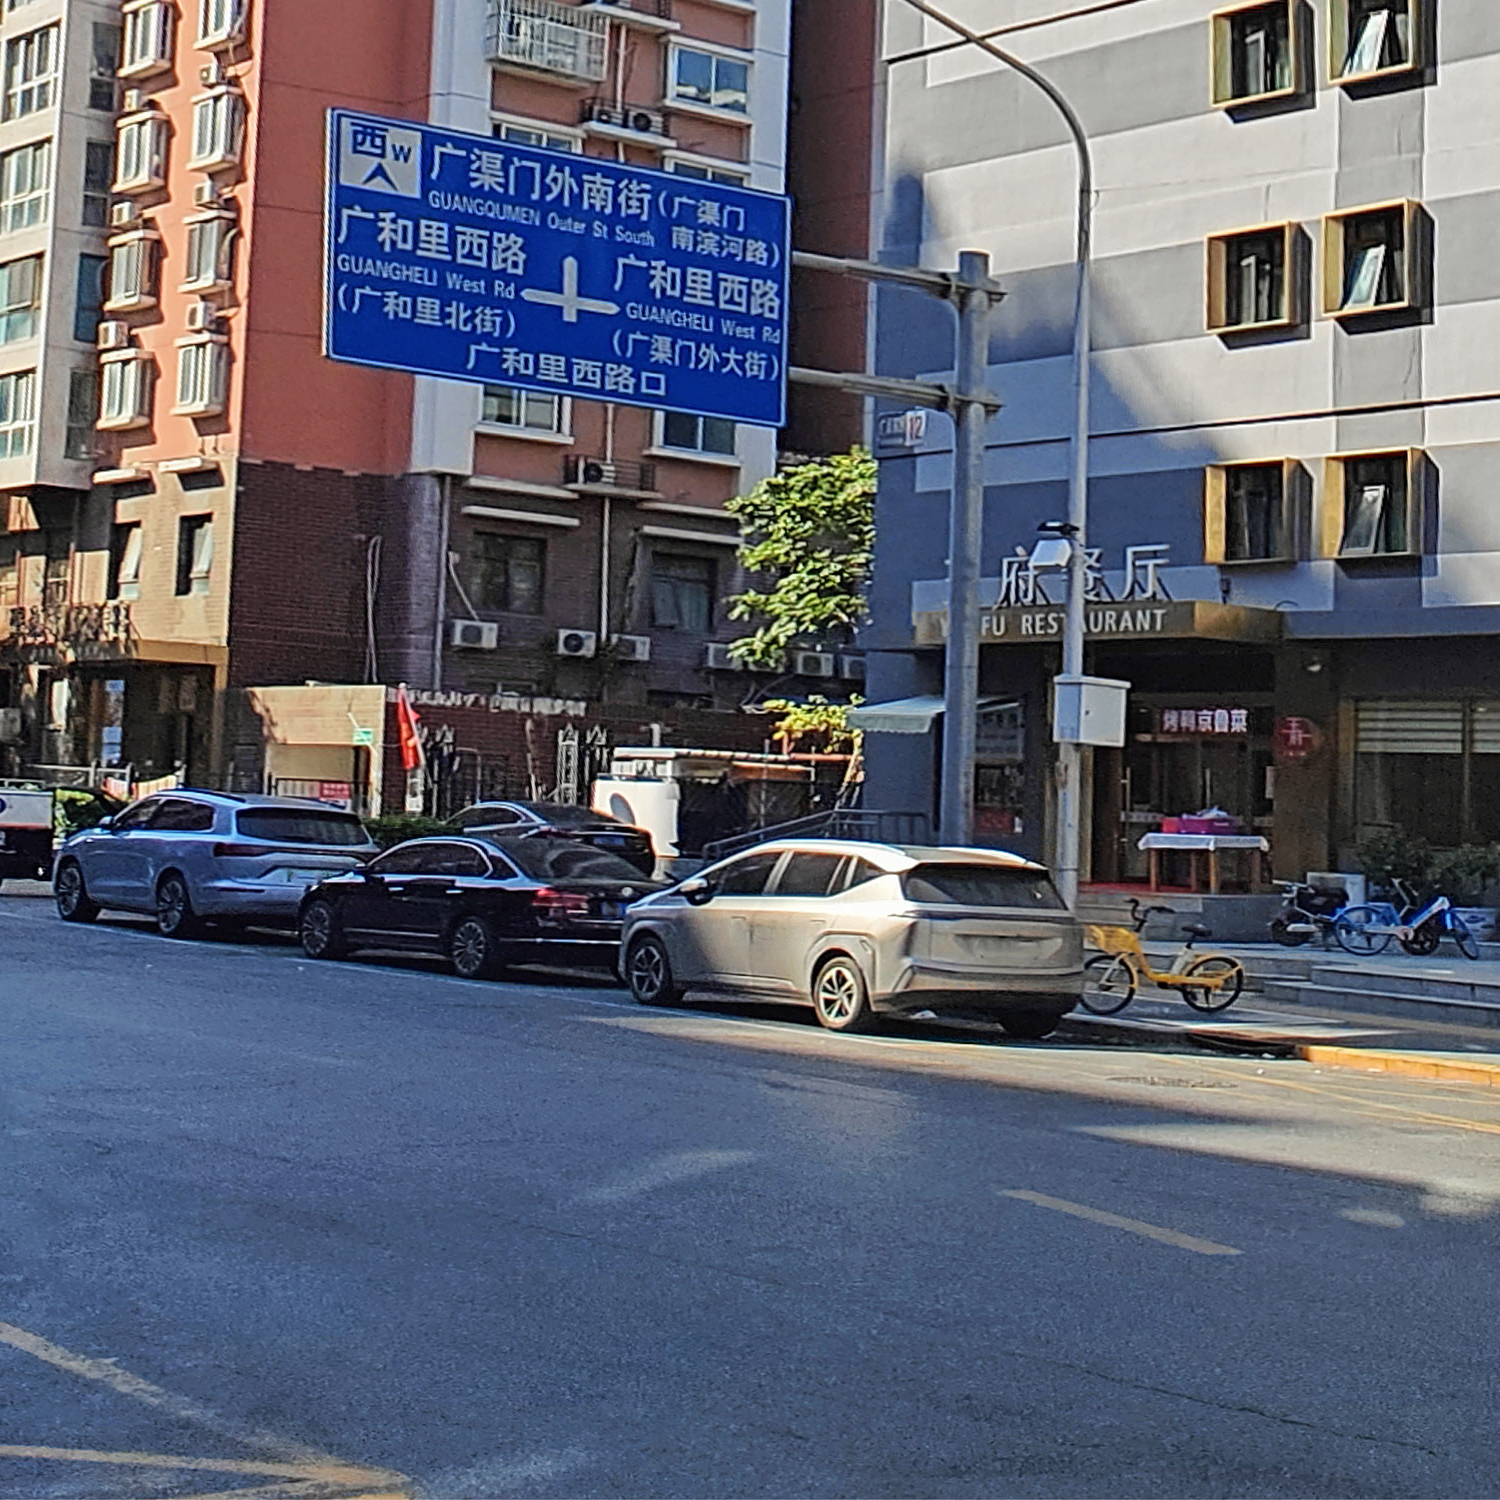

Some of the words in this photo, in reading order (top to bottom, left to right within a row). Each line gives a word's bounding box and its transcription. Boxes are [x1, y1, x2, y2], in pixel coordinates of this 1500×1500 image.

[349, 121, 389, 160] 西
[391, 143, 412, 164] W
[430, 142, 652, 222] 广渠门外南街
[337, 205, 527, 277] 广和里西路
[428, 190, 541, 227] GUANGQUMEN
[547, 212, 586, 234] Outer
[592, 220, 609, 239] St
[615, 225, 656, 248] South
[337, 253, 437, 286] GUANGHELI
[446, 271, 485, 295] West
[494, 279, 515, 300] Rd
[613, 253, 781, 320] 广和里西路
[625, 302, 714, 333] GUANGHELI
[721, 318, 755, 340] West
[762, 327, 781, 345] Rd
[466, 341, 666, 396] 广和里西路口
[1021, 608, 1167, 636] RESURANT
